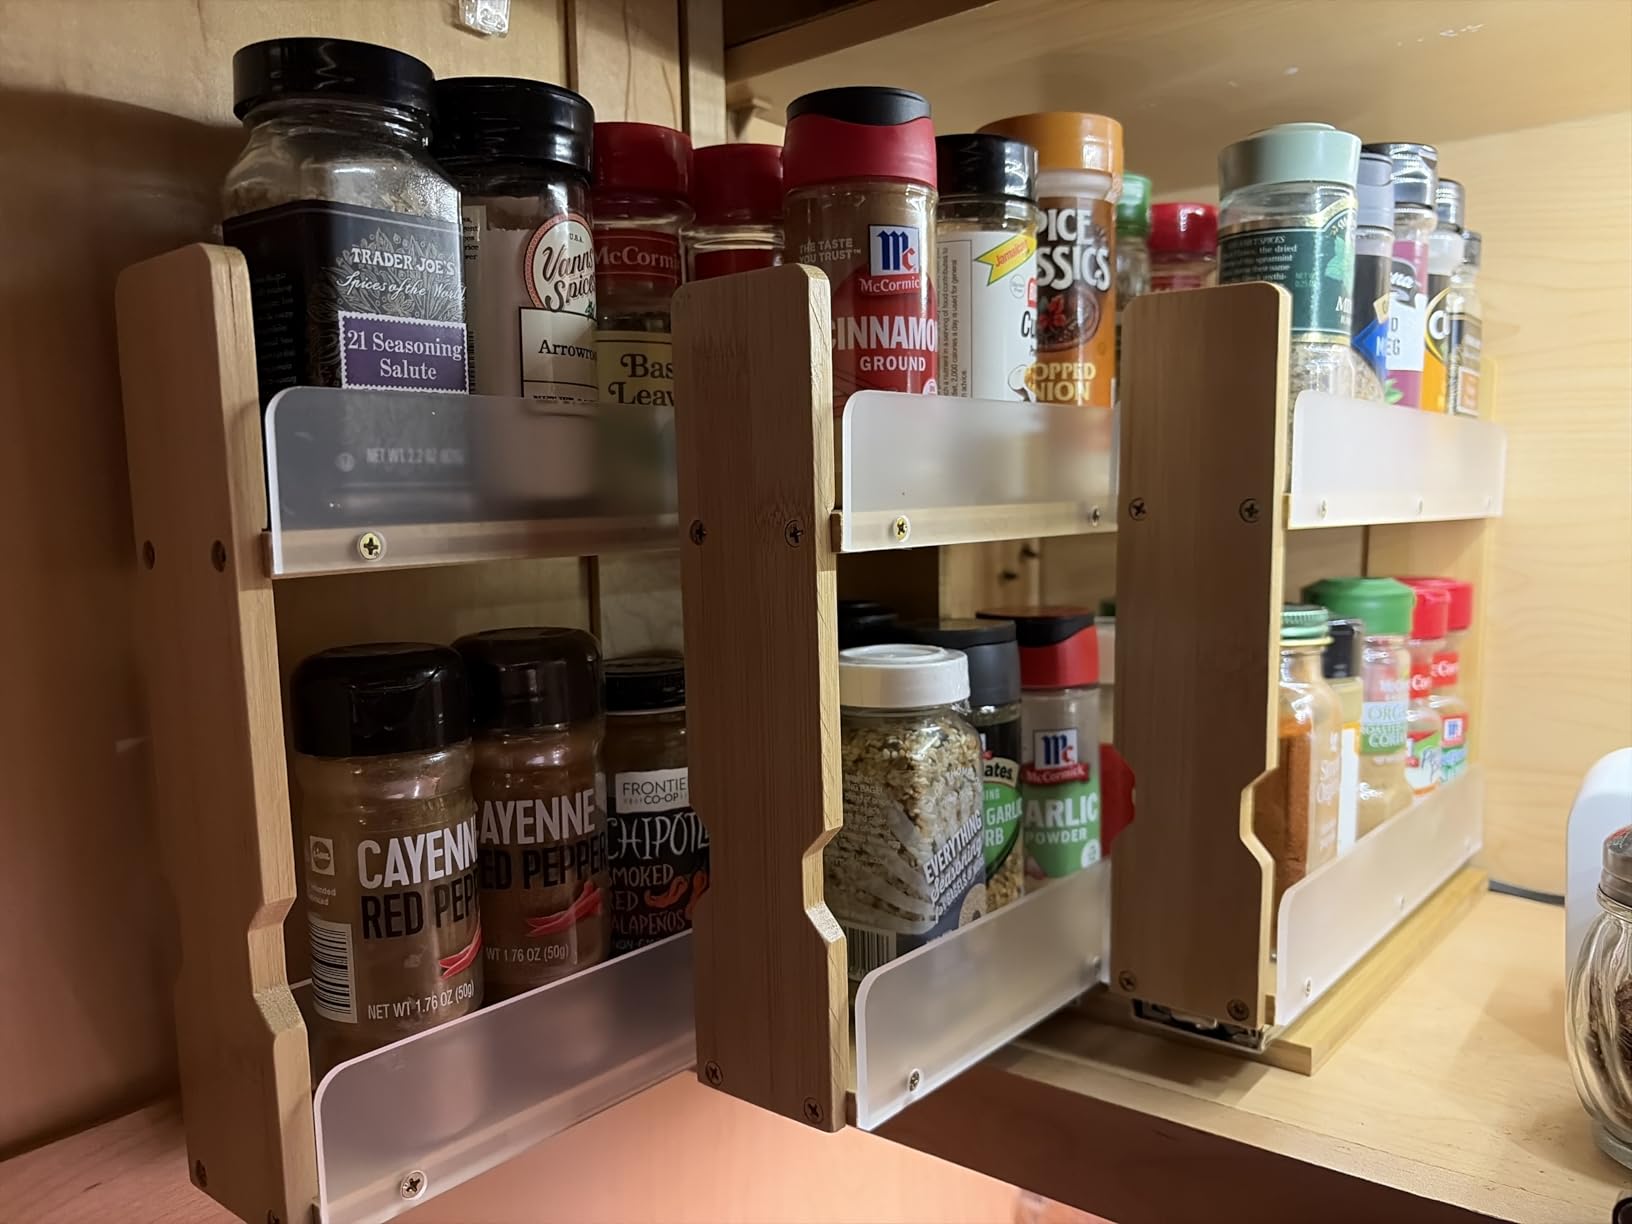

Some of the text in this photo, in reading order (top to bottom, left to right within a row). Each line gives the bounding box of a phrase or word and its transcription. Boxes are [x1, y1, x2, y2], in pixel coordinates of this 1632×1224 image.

[799, 238, 853, 254] THE TASTE
[1274, 244, 1297, 253] dried
[352, 248, 455, 275] TRADER JOE'S
[594, 245, 675, 269] McCorm
[799, 252, 817, 264] YOU
[336, 270, 386, 295] Spices
[388, 278, 412, 300] of
[404, 279, 427, 296] the
[347, 331, 462, 361] 21 Seasoning
[379, 358, 437, 380] Salute
[859, 355, 927, 372] GROUND
[950, 364, 958, 382] 2,000
[984, 763, 1013, 780] ates
[1025, 764, 1086, 781] McCormick
[643, 792, 679, 805] CO-OP
[476, 787, 596, 846] AYENNE
[1024, 791, 1098, 828] ARLIC
[923, 809, 983, 884] EVERYTHING
[984, 827, 1004, 848] RB
[1024, 827, 1088, 845] POWDER
[930, 838, 983, 907] Seasoning
[360, 867, 481, 940] RED PEP
[526, 946, 541, 961] OZ
[543, 942, 569, 962] (50g)
[368, 978, 475, 1020] NET WT 1.76 OZ (50g)
